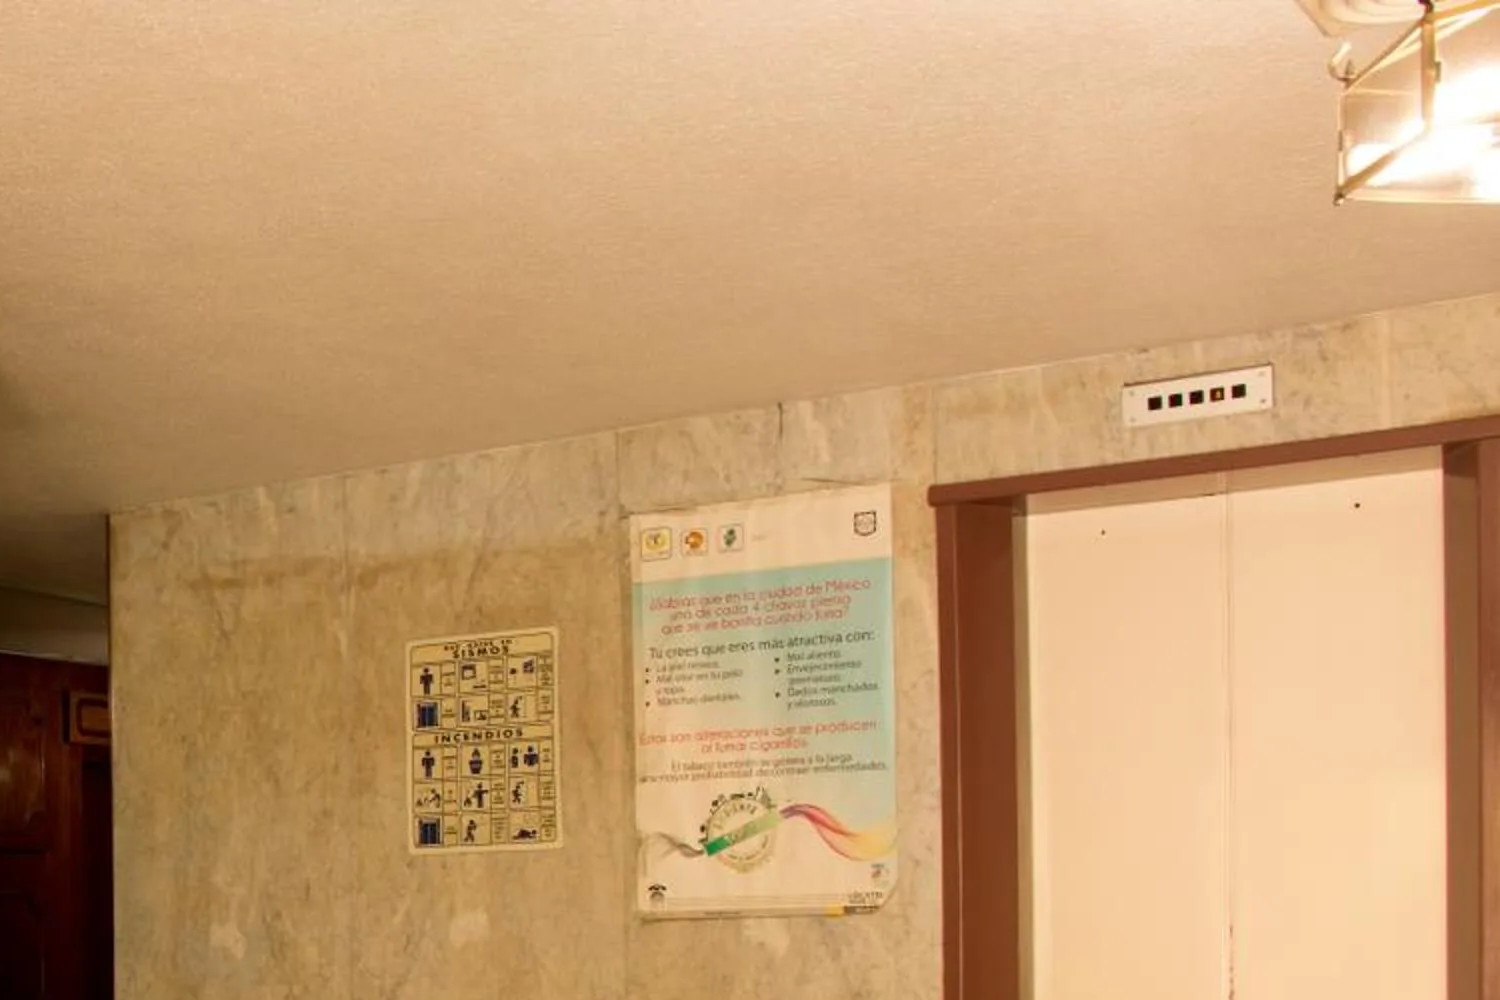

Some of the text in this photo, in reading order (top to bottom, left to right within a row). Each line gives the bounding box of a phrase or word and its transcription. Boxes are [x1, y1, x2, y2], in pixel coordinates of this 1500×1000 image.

[452, 644, 509, 660] SISMOS
[702, 643, 726, 657] que
[787, 631, 843, 648] atractiva
[434, 728, 524, 744] INCENDIOS
